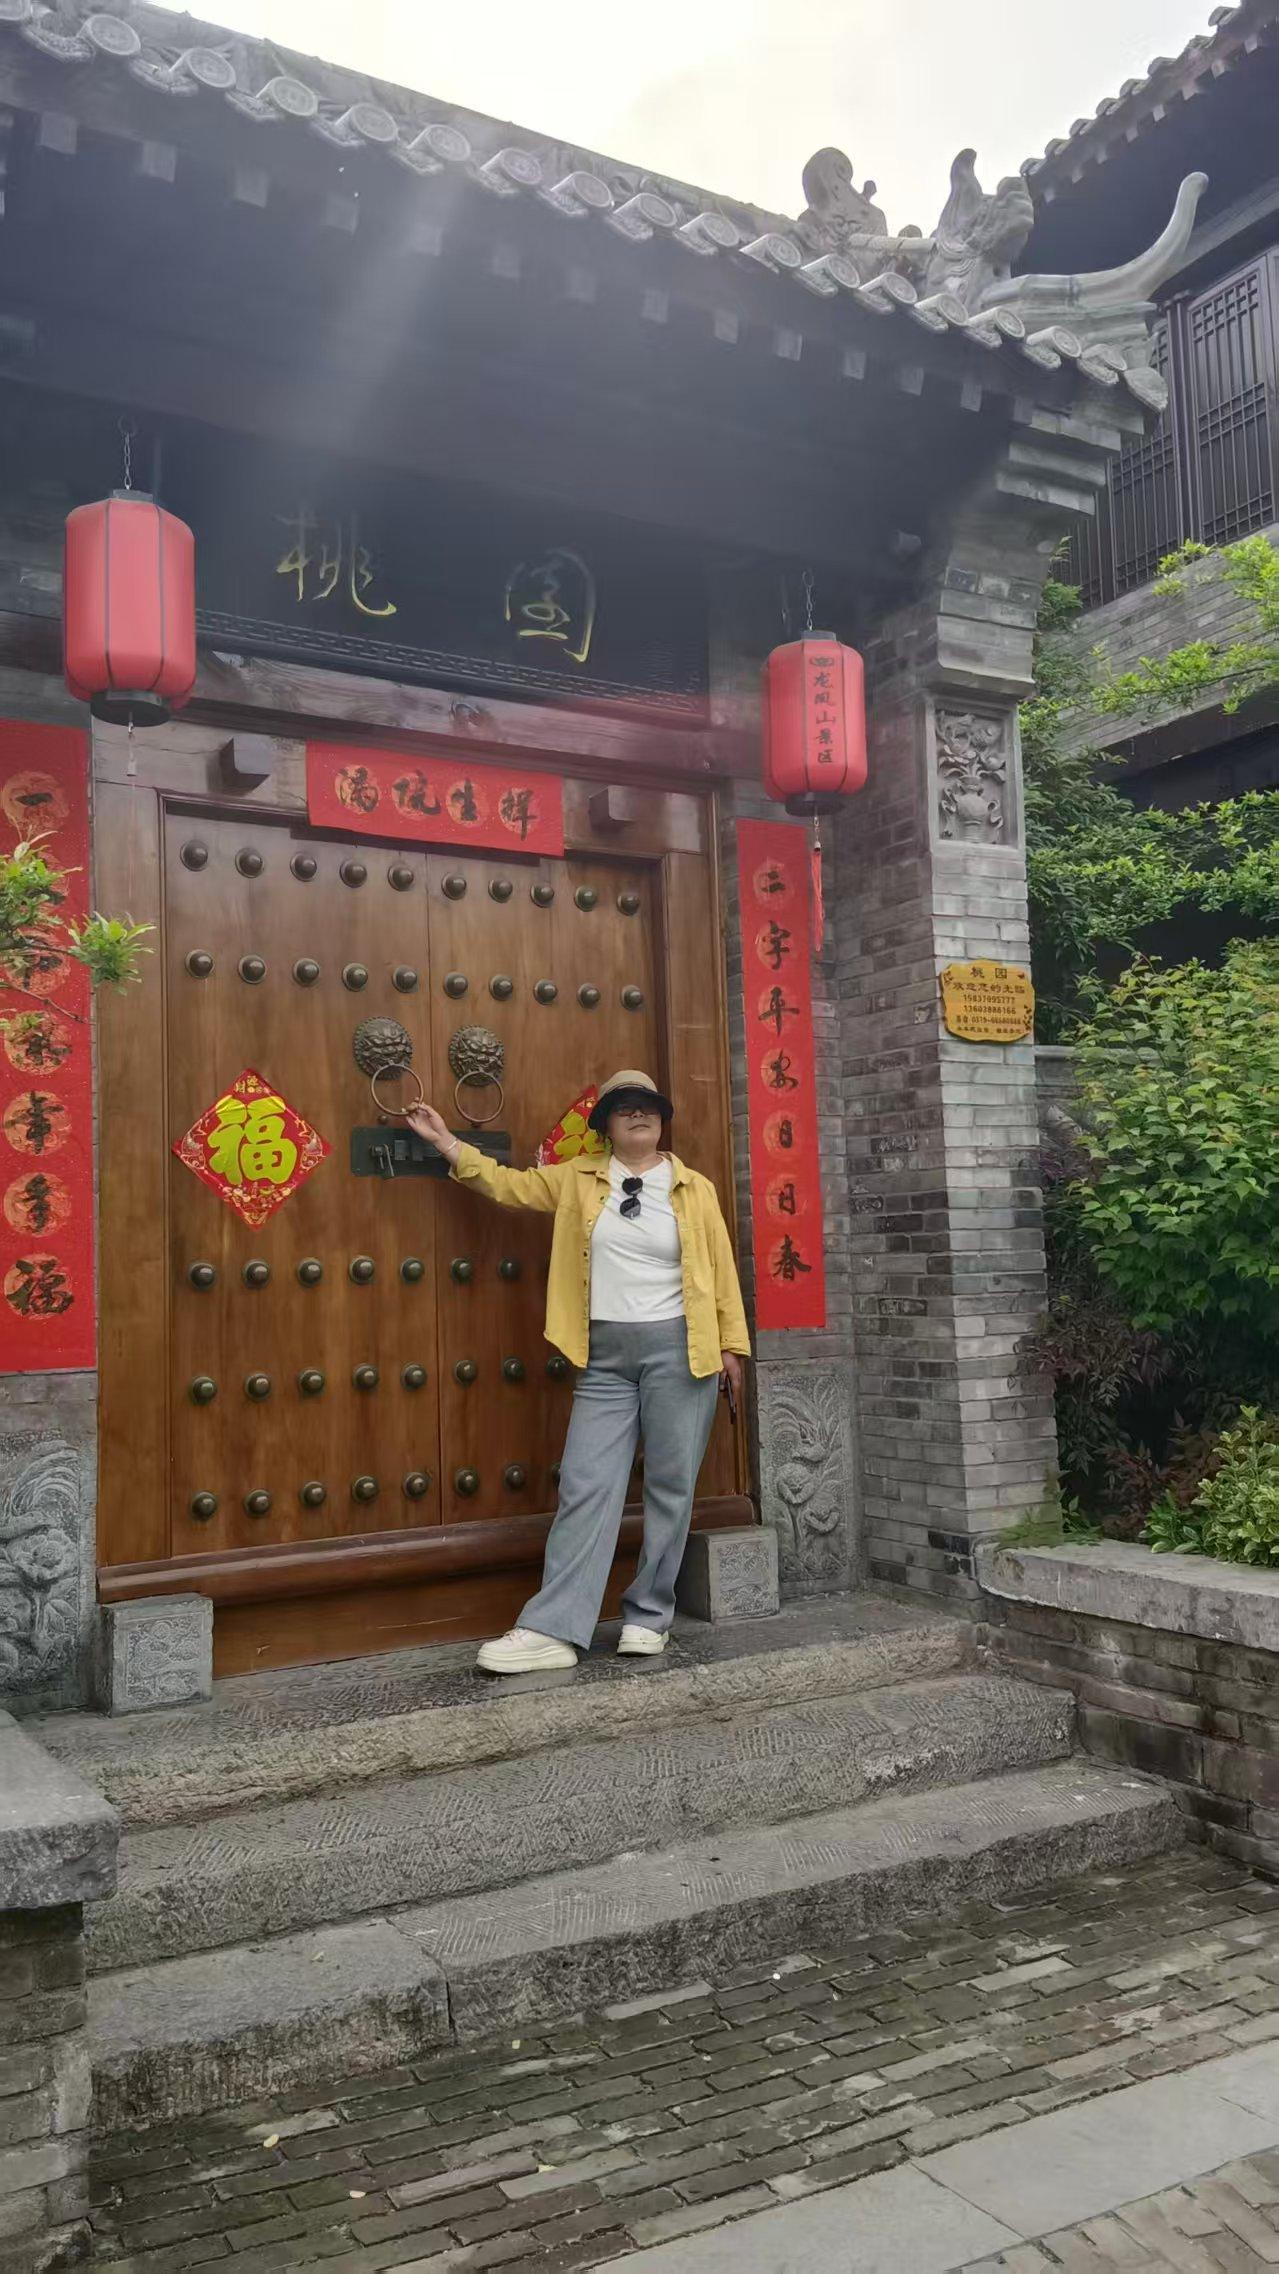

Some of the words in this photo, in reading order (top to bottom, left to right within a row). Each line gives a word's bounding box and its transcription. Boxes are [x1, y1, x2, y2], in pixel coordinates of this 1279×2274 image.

[207, 1095, 298, 1186] 福
[757, 870, 812, 1284] 二字平安日日春
